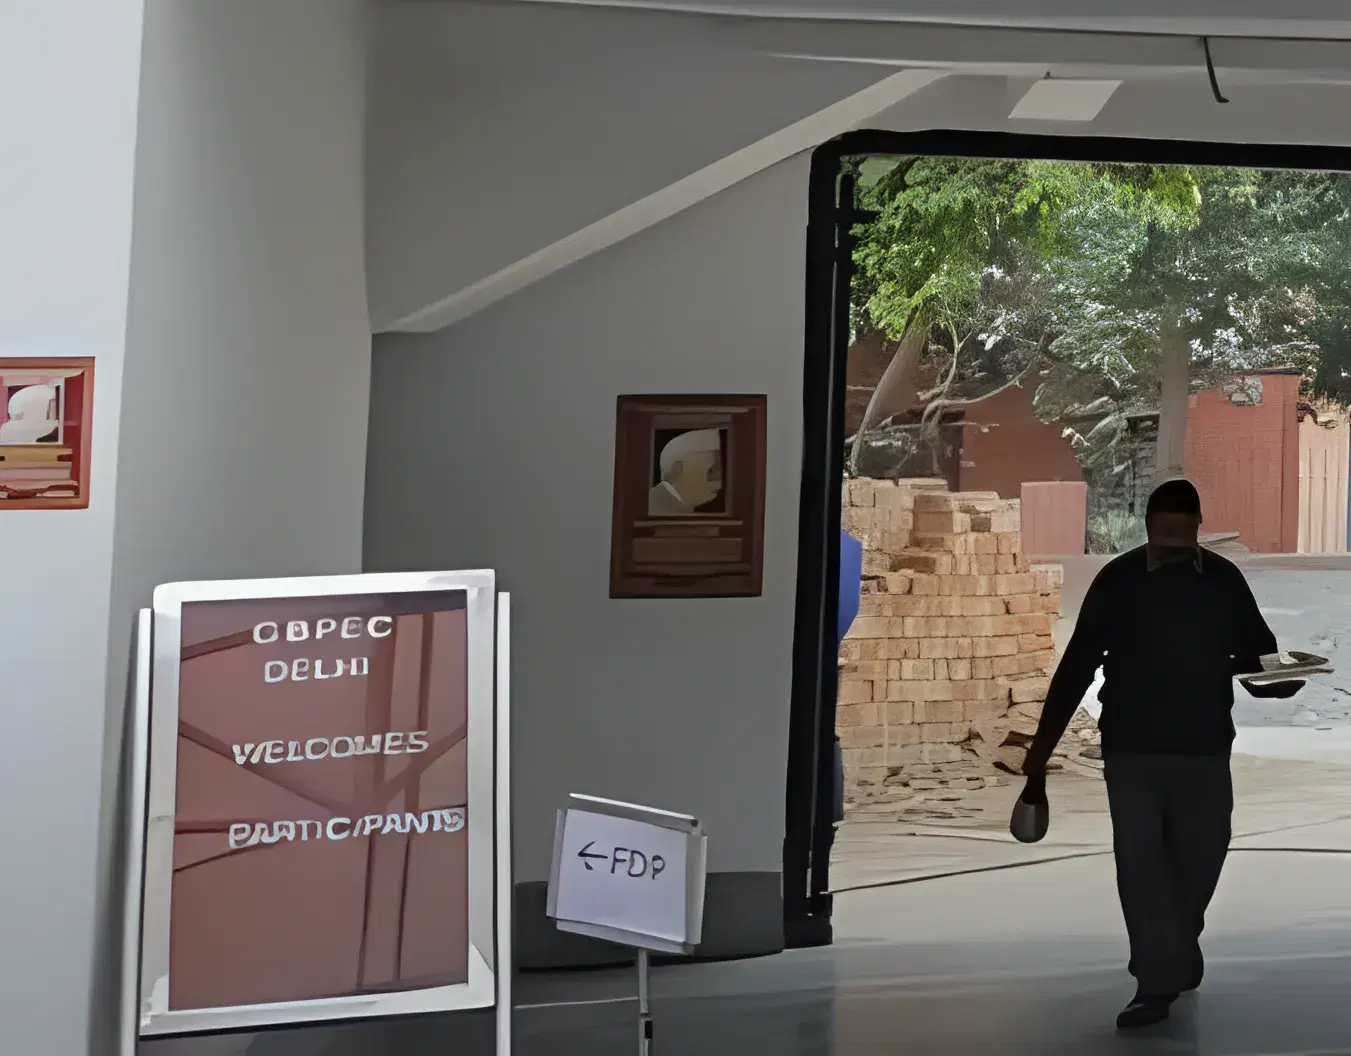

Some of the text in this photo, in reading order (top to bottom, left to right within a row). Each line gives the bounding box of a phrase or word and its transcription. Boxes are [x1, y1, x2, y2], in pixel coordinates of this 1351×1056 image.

[263, 656, 370, 684] DELHI
[231, 730, 430, 766] WELCOMES
[610, 846, 667, 881] FDP
